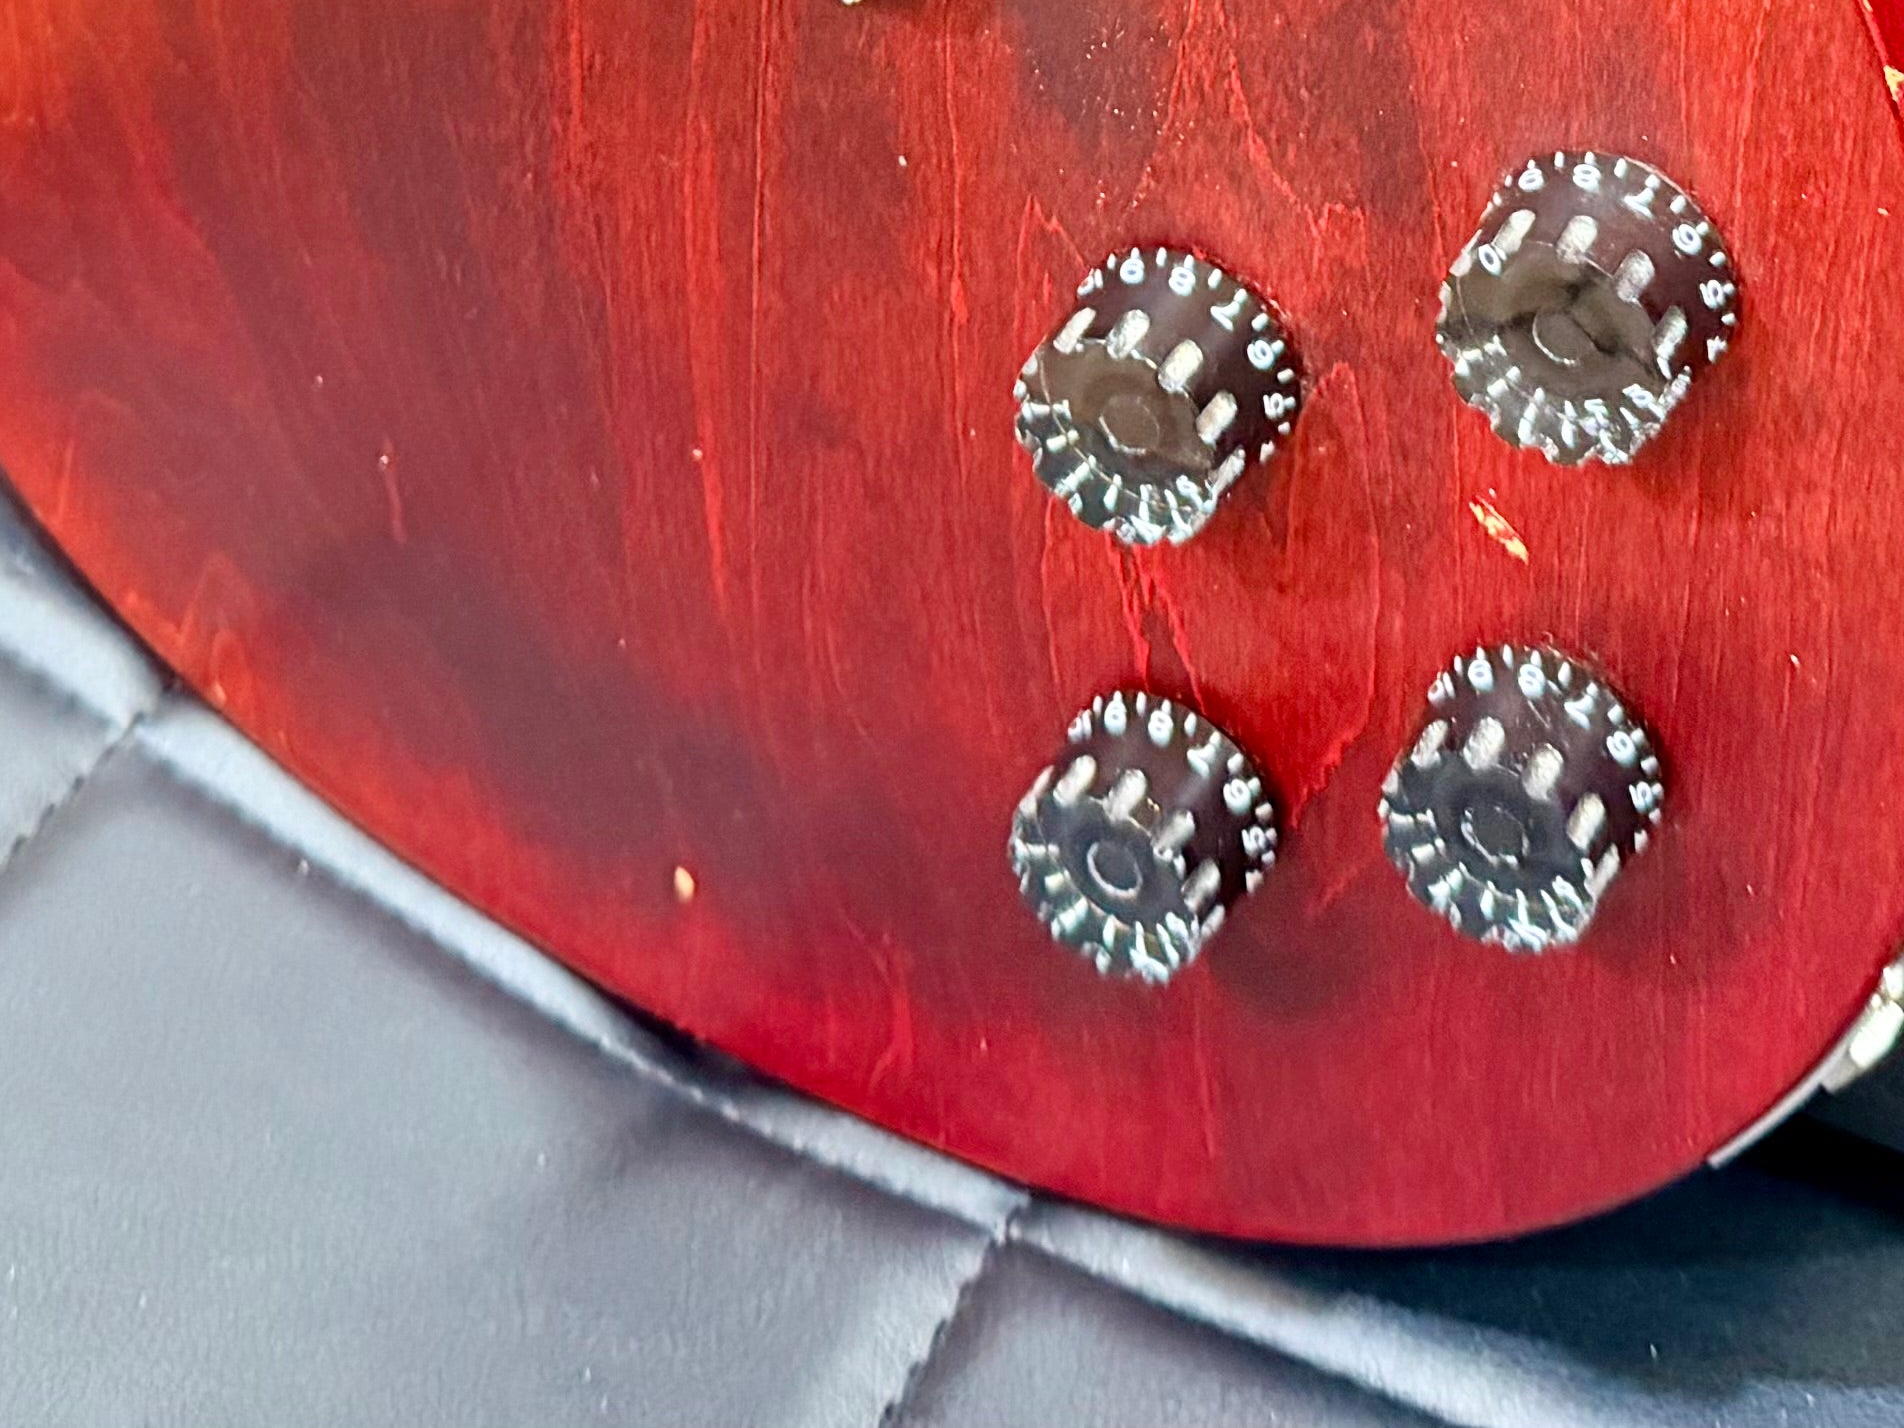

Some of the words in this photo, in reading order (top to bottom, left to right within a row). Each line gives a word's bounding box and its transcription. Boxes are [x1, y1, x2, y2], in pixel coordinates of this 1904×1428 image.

[1573, 164, 1601, 191] 8
[1623, 188, 1654, 219] 7
[1168, 266, 1195, 295] 8
[1210, 301, 1240, 331] 7
[1518, 663, 1546, 701] 8
[1148, 710, 1174, 748] 8
[1564, 695, 1595, 730] 7
[1186, 743, 1217, 778] 7
